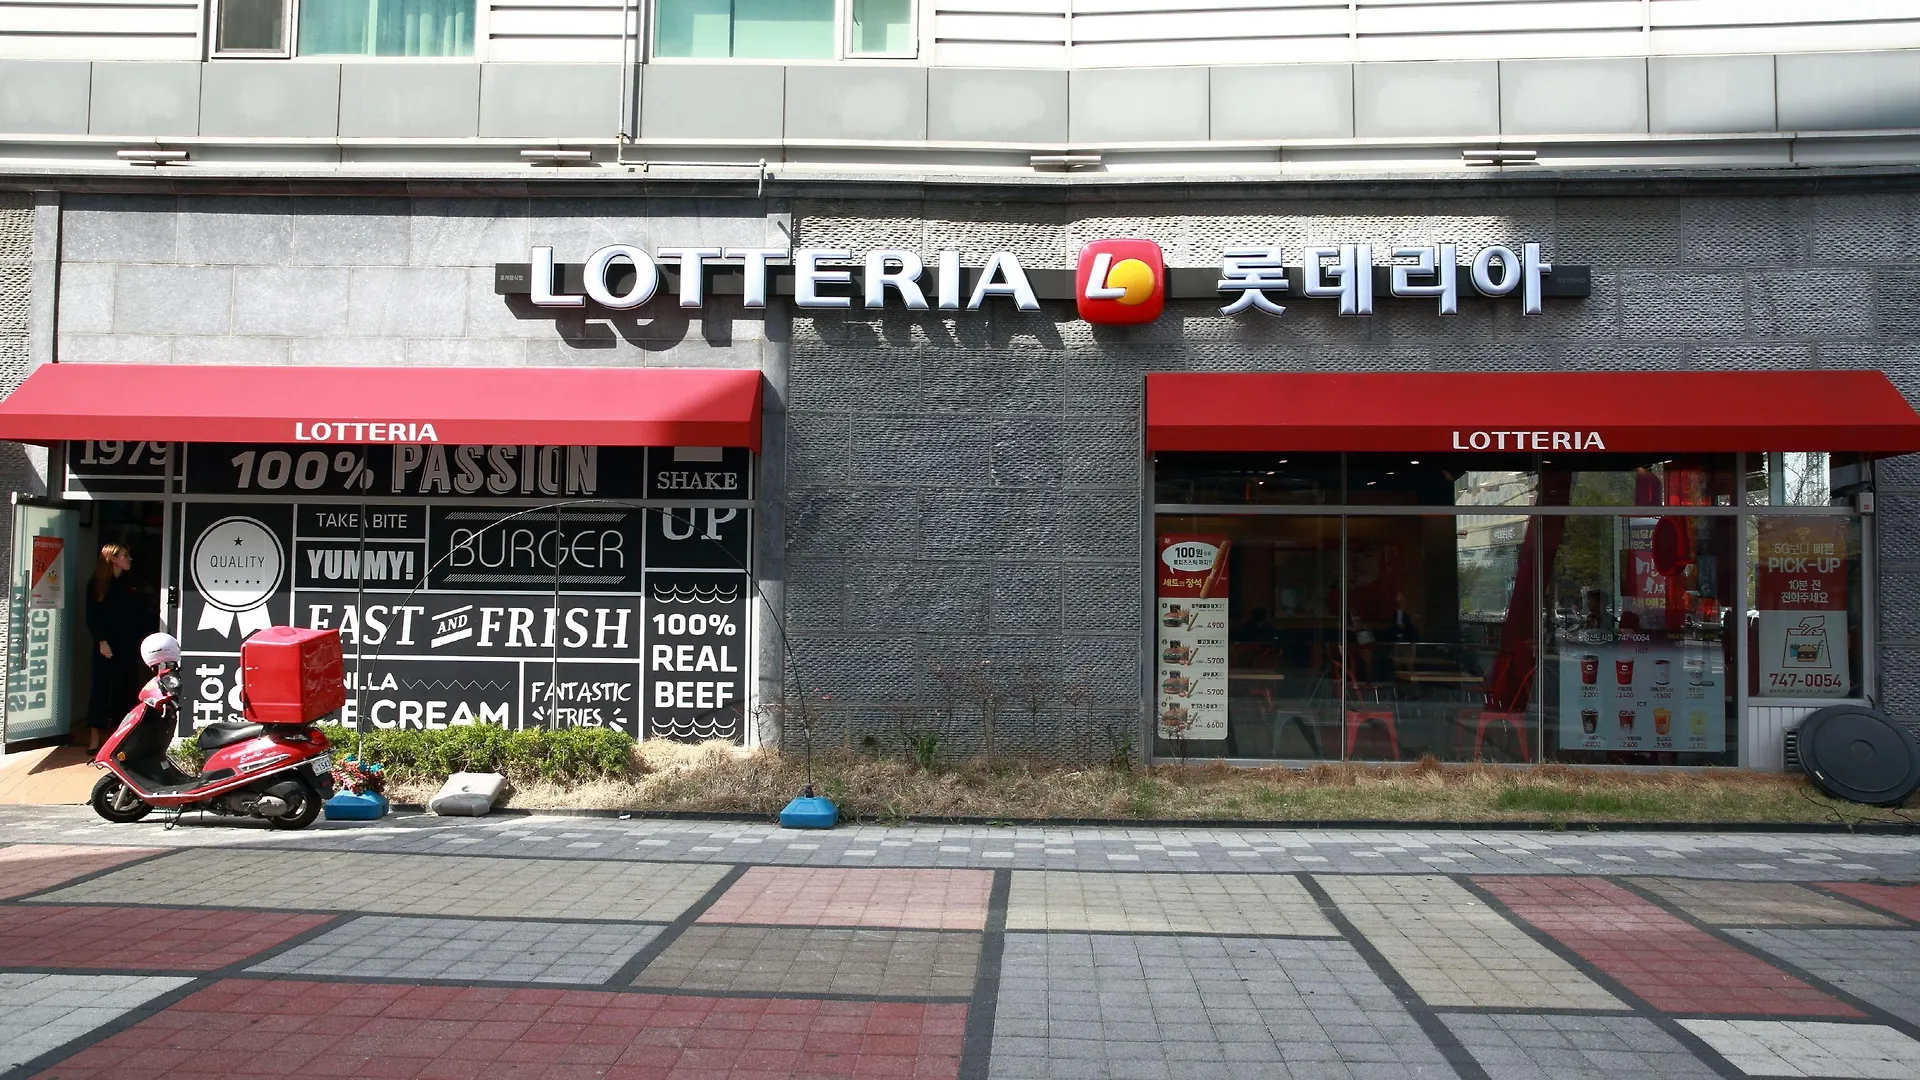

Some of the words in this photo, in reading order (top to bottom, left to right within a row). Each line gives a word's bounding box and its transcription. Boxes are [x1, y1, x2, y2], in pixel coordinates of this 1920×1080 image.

[531, 244, 1042, 311] LOTTERIA
[1217, 242, 1552, 317] 롯데리아
[294, 422, 438, 443] LOTTERIA
[1452, 431, 1606, 450] LOTTERIA
[80, 440, 167, 466] 1979
[231, 450, 374, 490] 100%
[391, 444, 598, 496] PASSION
[657, 471, 738, 491] SHAKE
[316, 512, 358, 529] TAKE
[372, 514, 408, 530] BITE
[661, 507, 738, 541] UP
[450, 528, 625, 569] BURGER
[209, 555, 266, 569] QUALITY
[307, 549, 414, 581] YUMMY!
[1768, 557, 1841, 574] PICK-UP
[1185, 578, 1203, 588] 정석
[1788, 579, 1808, 591] 10분
[1811, 579, 1821, 591] 전
[1781, 592, 1829, 604] 전화주세요
[308, 604, 424, 646] FAST
[436, 614, 470, 635] AND
[652, 613, 737, 636] 100%
[652, 645, 738, 672] REAL
[343, 672, 399, 691] NILLA
[1769, 673, 1842, 688] 747-0054
[532, 682, 632, 703] FANTASTIC
[655, 681, 734, 709] BEEF
[371, 699, 509, 730] CREAM
[548, 708, 603, 727] FRIES
